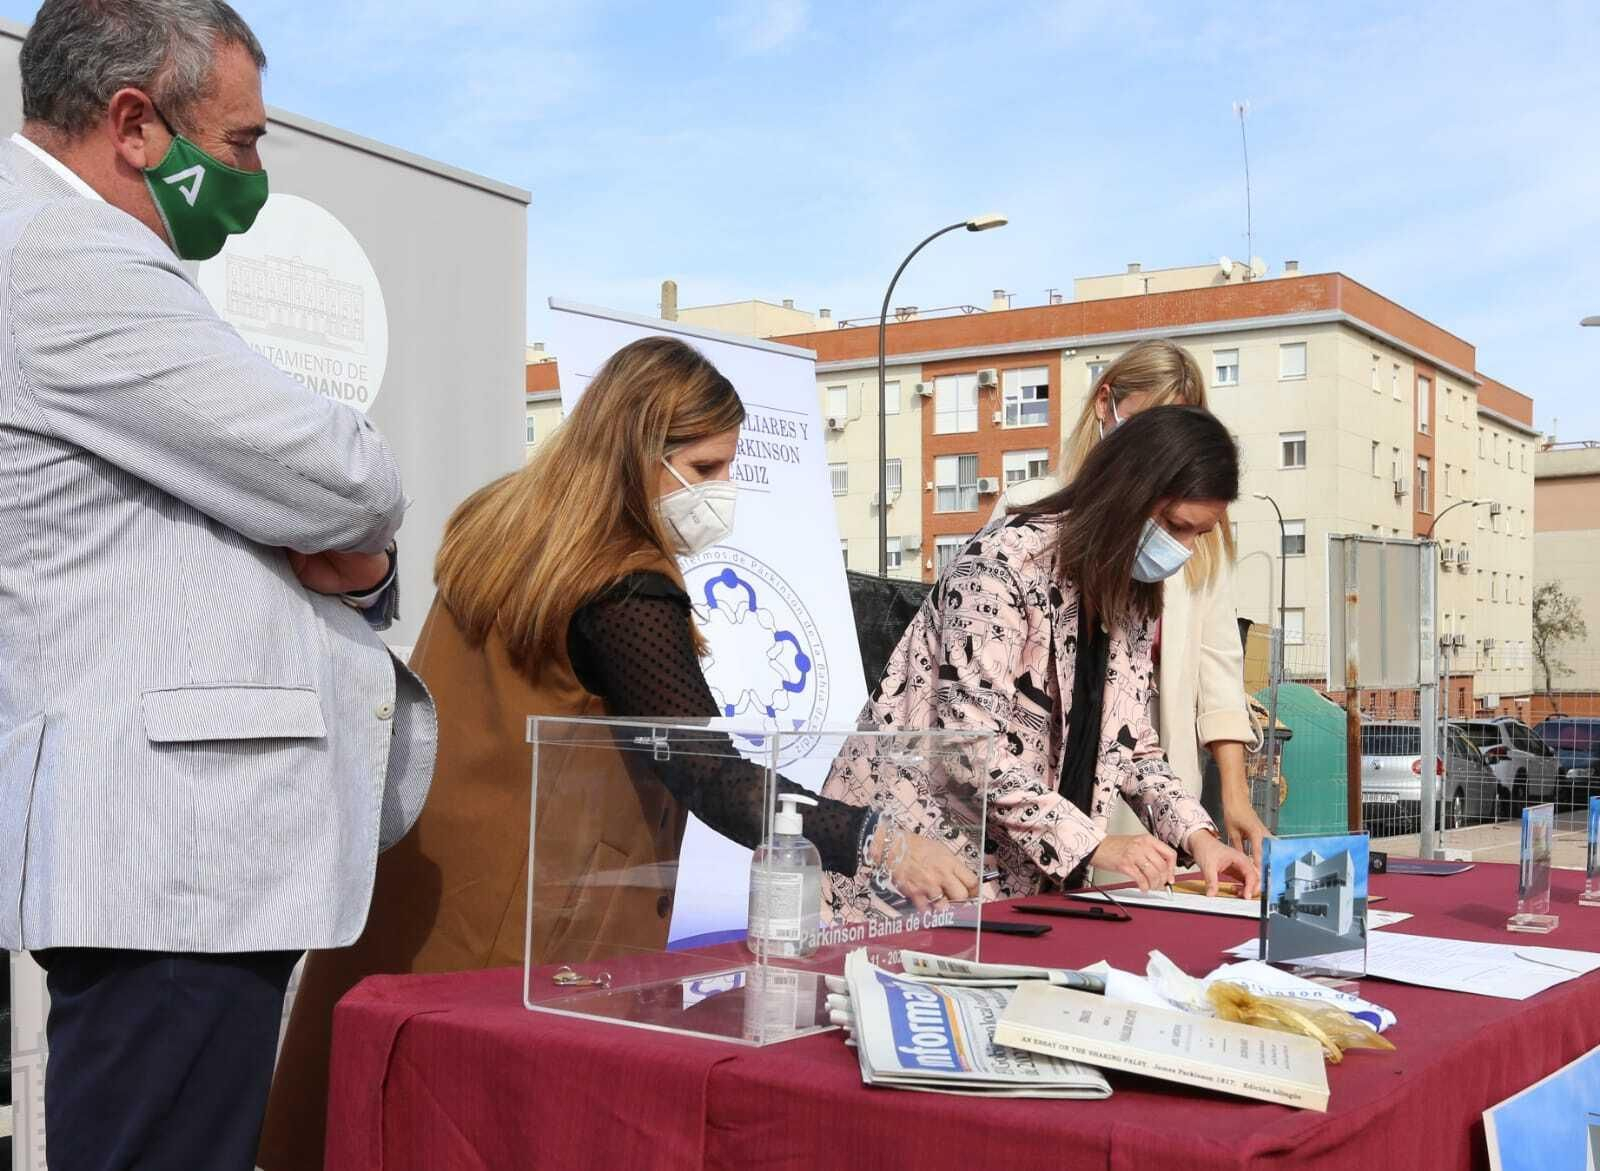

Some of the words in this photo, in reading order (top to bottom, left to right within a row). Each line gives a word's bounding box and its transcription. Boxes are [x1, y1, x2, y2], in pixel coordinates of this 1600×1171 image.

[347, 362, 368, 381] DE
[799, 422, 808, 441] Y
[737, 438, 800, 464] RKINSON
[800, 924, 865, 948] Parkinson
[906, 913, 920, 932] de
[923, 908, 954, 928] Cádiz
